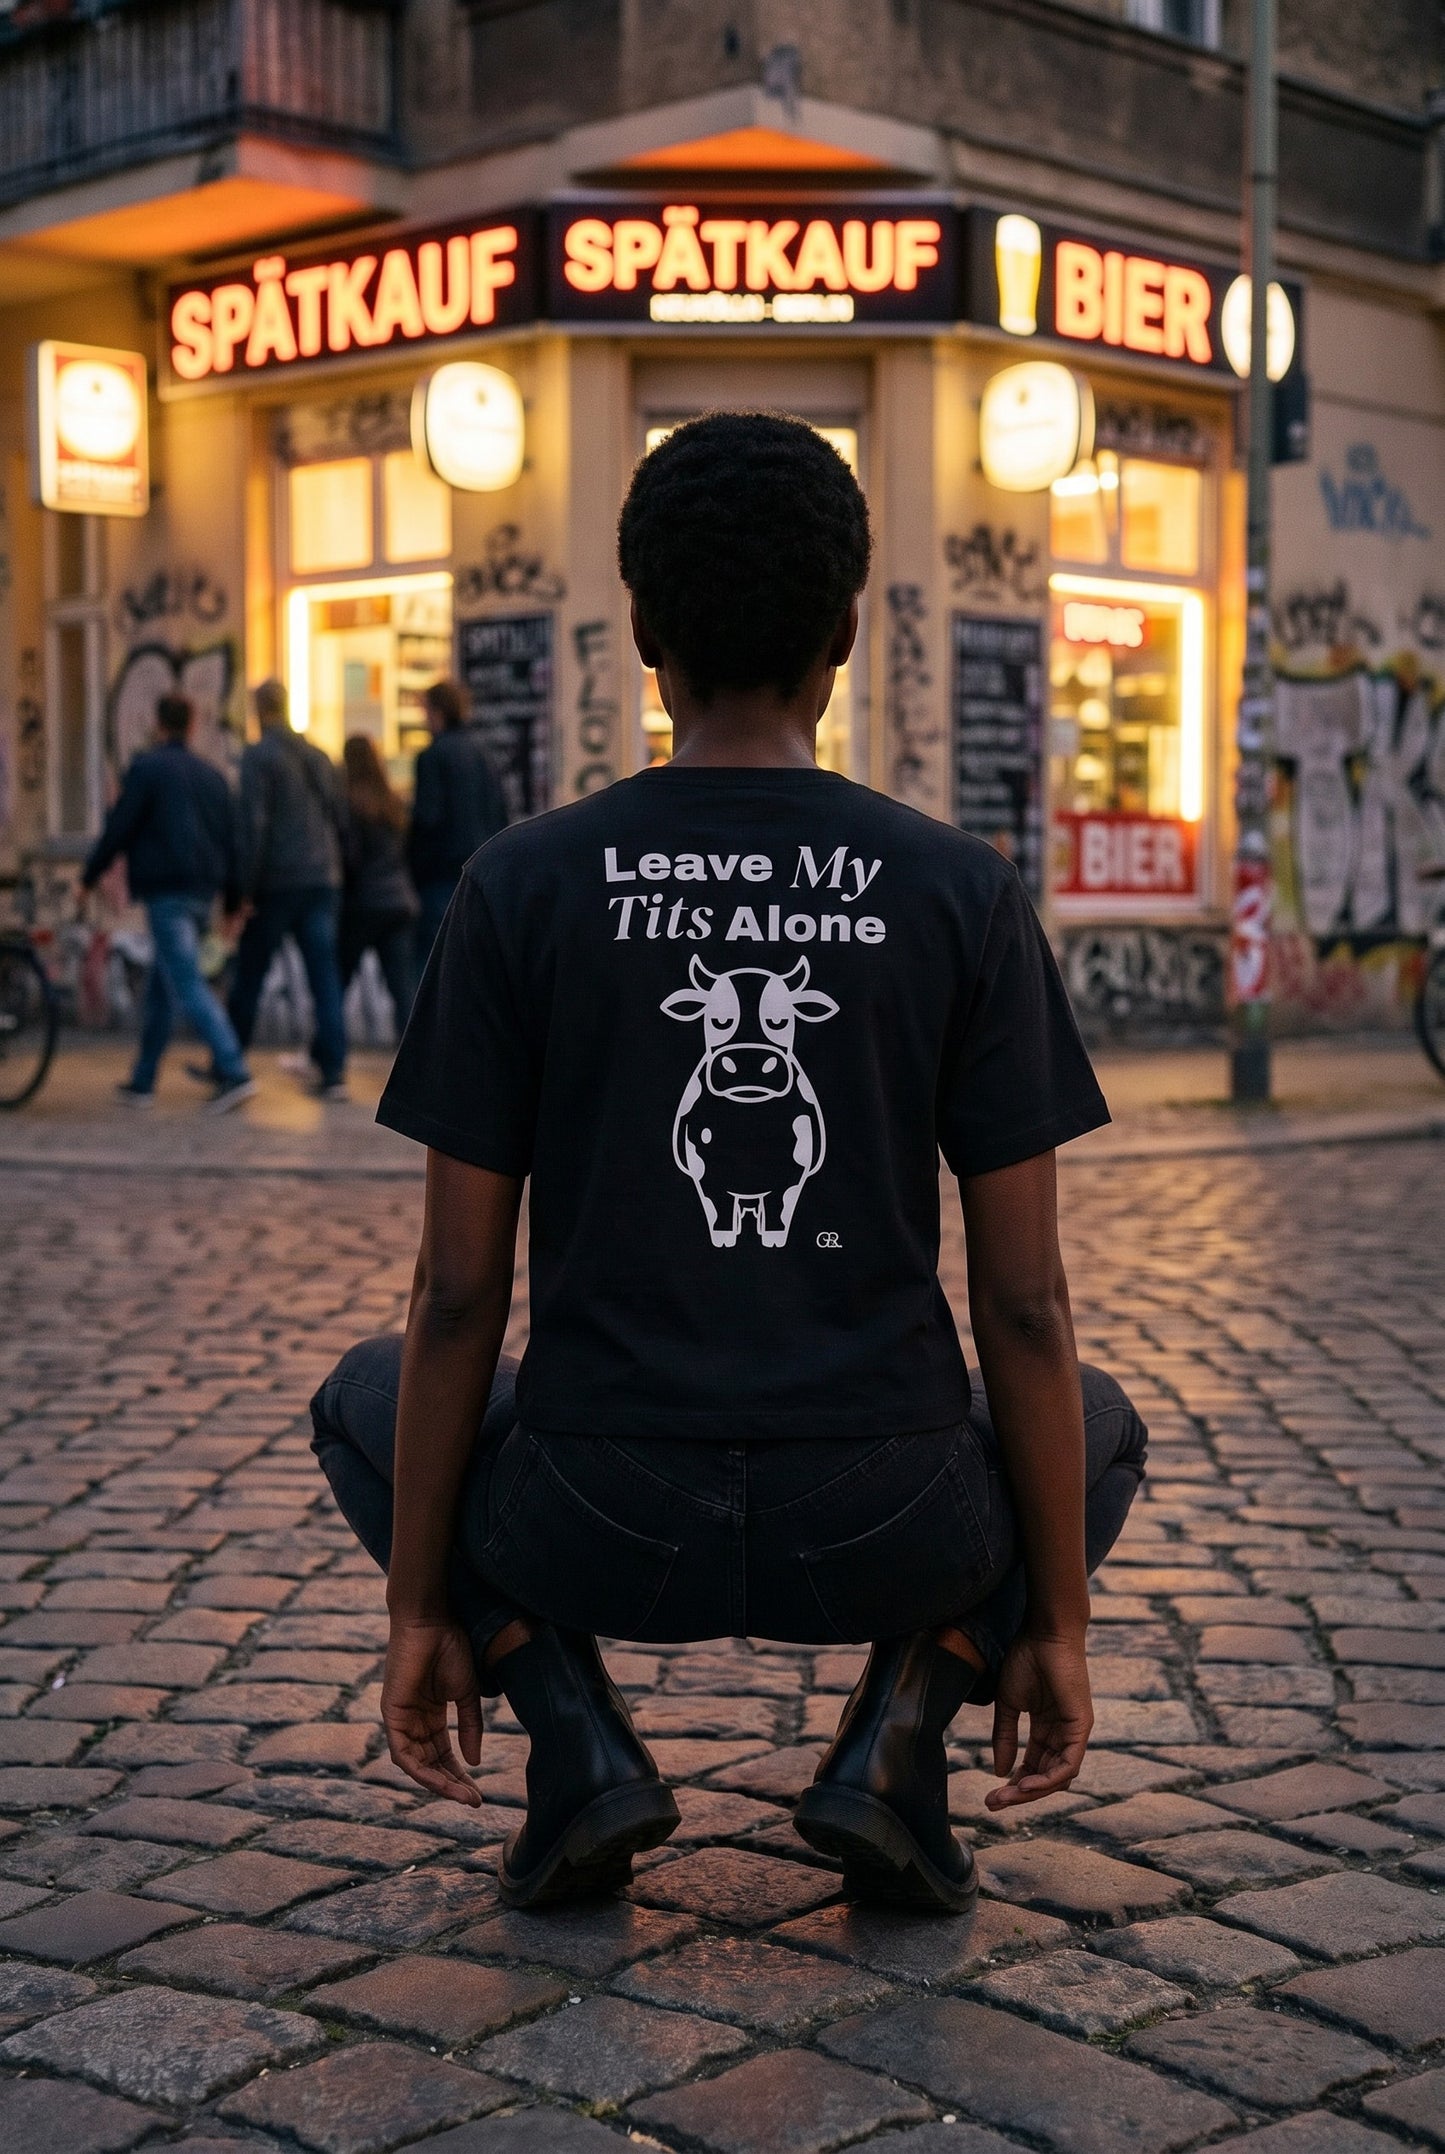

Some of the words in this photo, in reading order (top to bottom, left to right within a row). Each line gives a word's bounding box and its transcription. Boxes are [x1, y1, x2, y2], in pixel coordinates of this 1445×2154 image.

[564, 205, 941, 292] SPÄTKAUF
[171, 226, 518, 380] SPÄTKAUF
[1055, 240, 1213, 364] BIER
[604, 847, 773, 882] Leave
[789, 845, 883, 902] My
[1081, 820, 1185, 888] BIER
[608, 892, 714, 941] Tits
[725, 904, 886, 944] Alone
